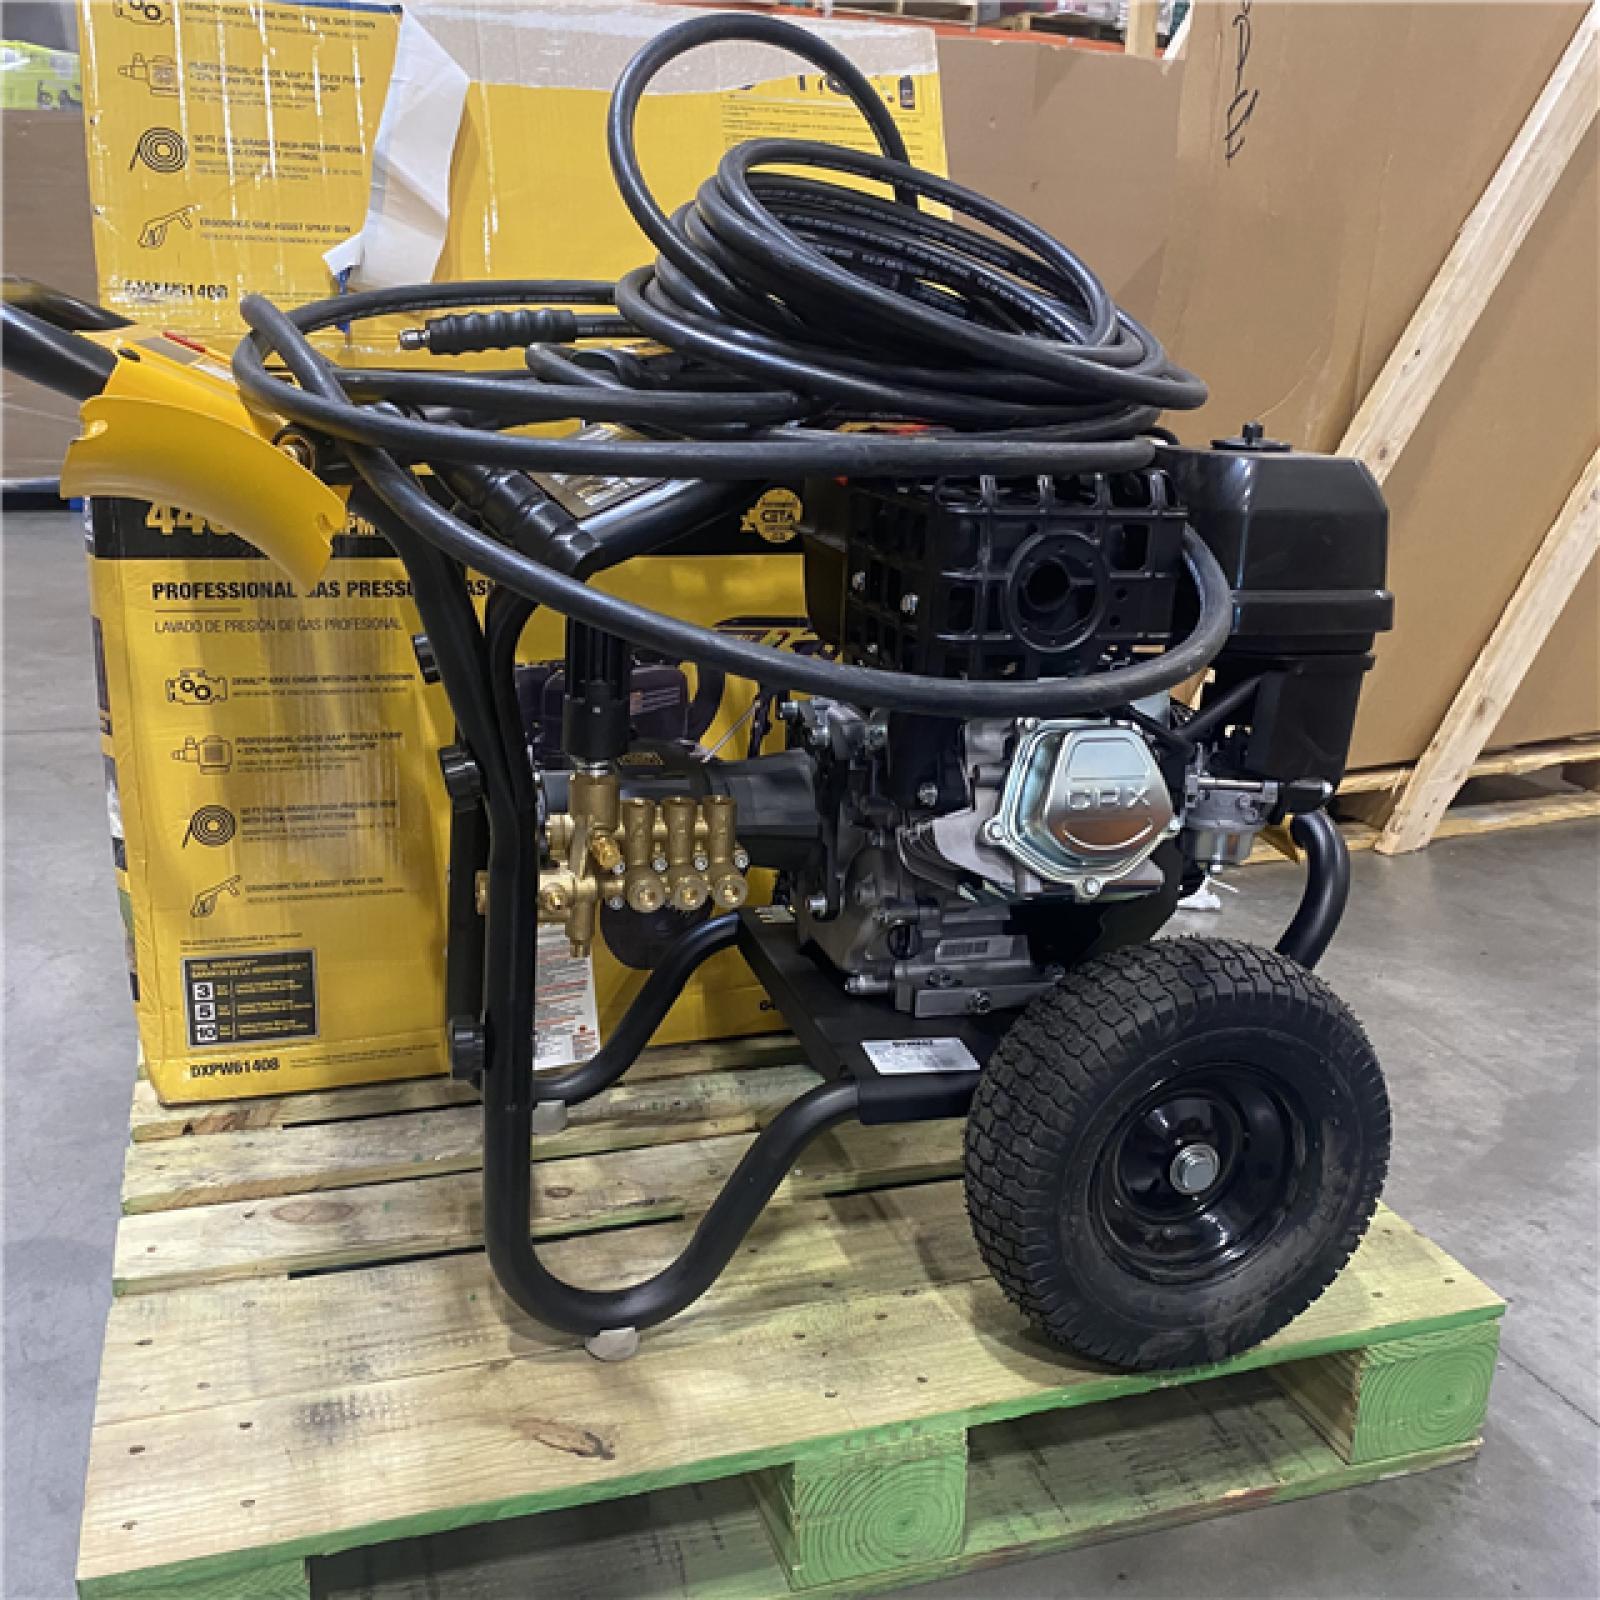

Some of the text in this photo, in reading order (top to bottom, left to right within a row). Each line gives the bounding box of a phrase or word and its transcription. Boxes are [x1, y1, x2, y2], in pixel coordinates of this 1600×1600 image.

[152, 581, 298, 601] PROFESSIONAL
[154, 618, 203, 633] LAVADO
[204, 618, 223, 632] DE
[280, 618, 297, 632] DE
[298, 617, 323, 632] GAS
[324, 616, 404, 632] PROFESIONAL
